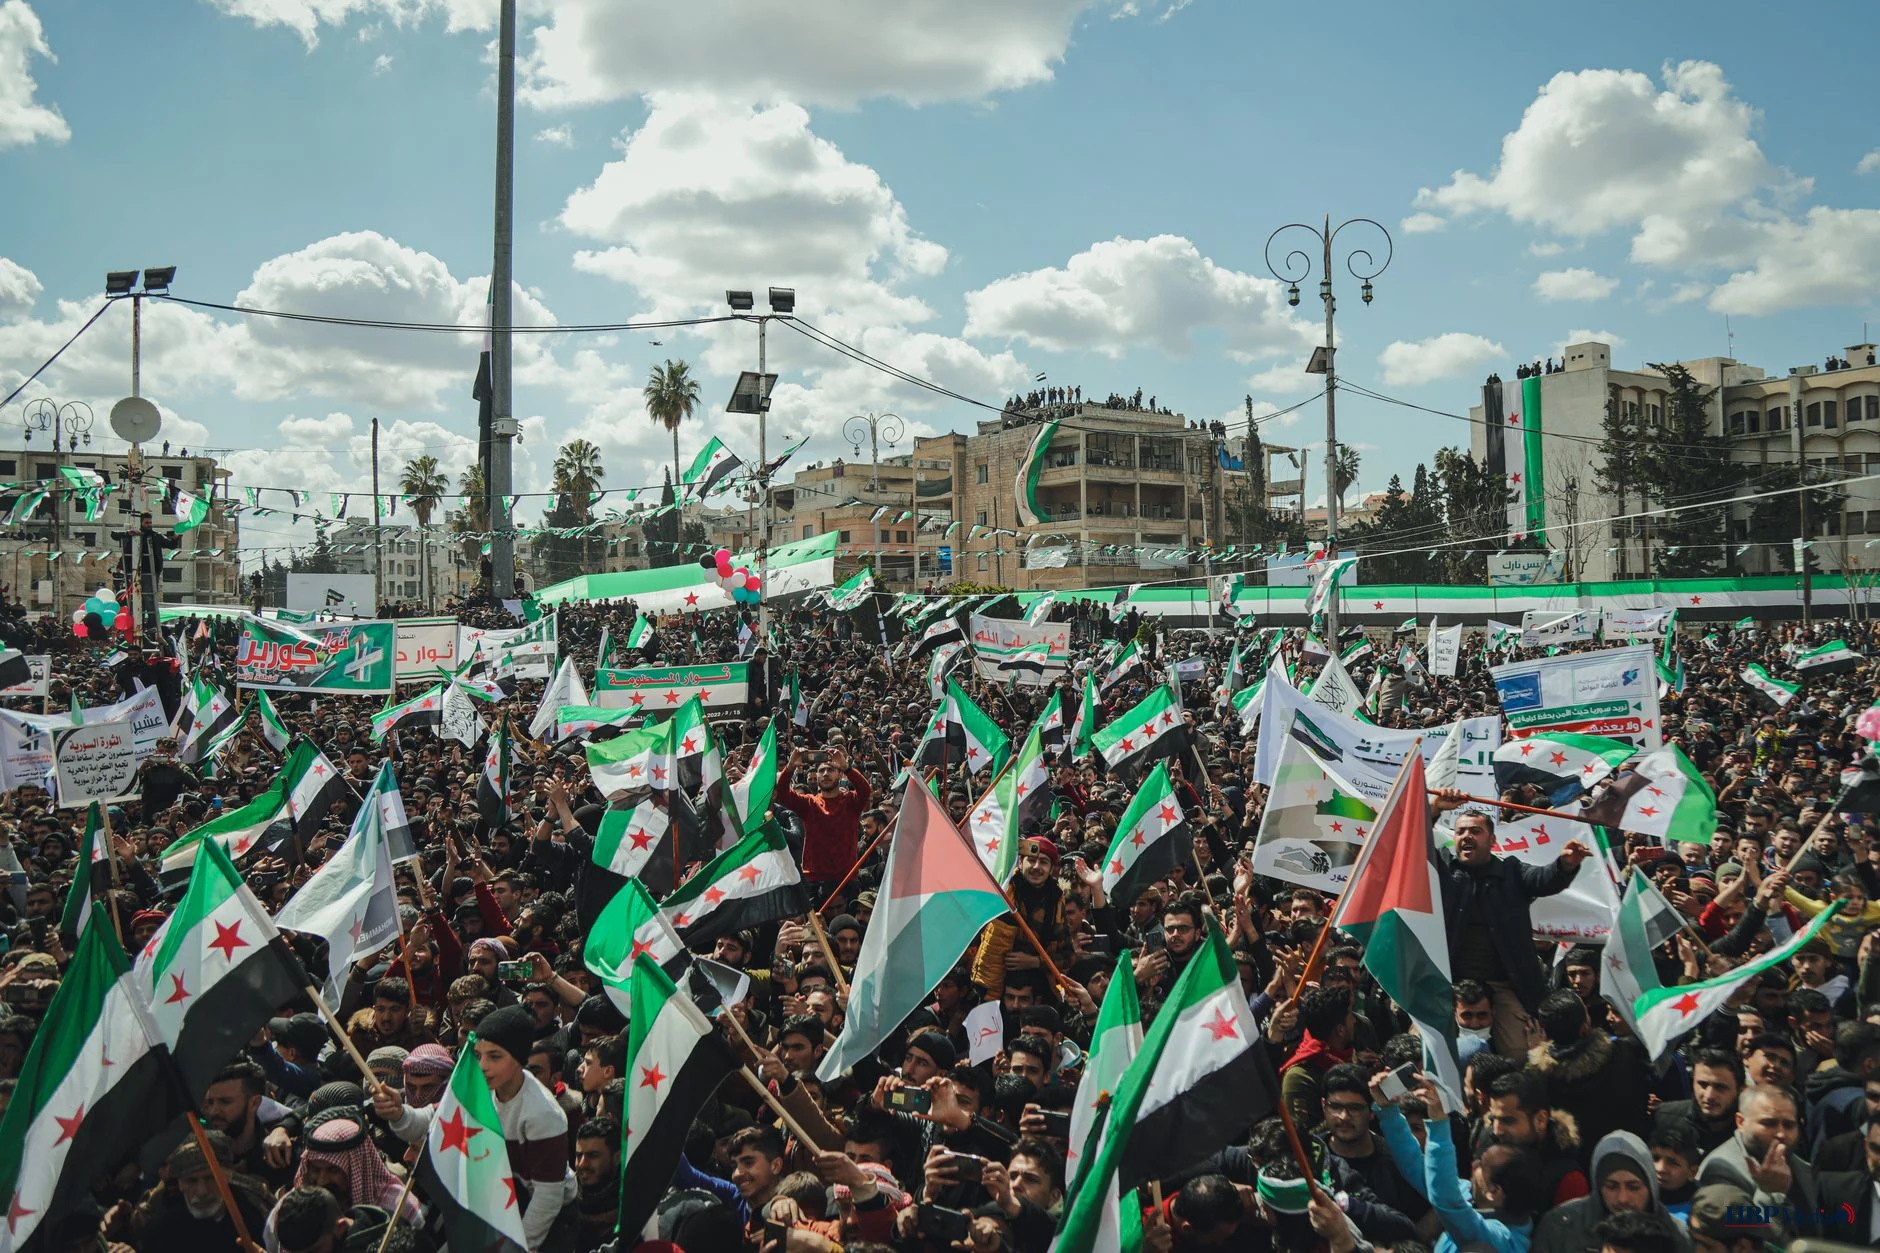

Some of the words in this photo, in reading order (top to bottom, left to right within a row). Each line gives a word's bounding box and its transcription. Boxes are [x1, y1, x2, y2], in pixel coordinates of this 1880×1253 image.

[316, 627, 350, 655] ثوار
[974, 629, 999, 645] الله
[236, 631, 318, 672] كورين
[415, 640, 453, 664] ثوار
[607, 672, 680, 688] المسطومة
[682, 665, 731, 685] ثوار
[1590, 706, 1611, 715] سوريا
[1611, 703, 1628, 714] نريد
[1625, 720, 1640, 732] ولا
[100, 734, 122, 750] الثورة
[1462, 728, 1490, 742] ثوا
[69, 736, 99, 753] السورية
[108, 748, 134, 760] مستمرون
[67, 765, 89, 775] والحرية
[90, 762, 114, 773] الكرامة
[114, 760, 129, 770] تجمع
